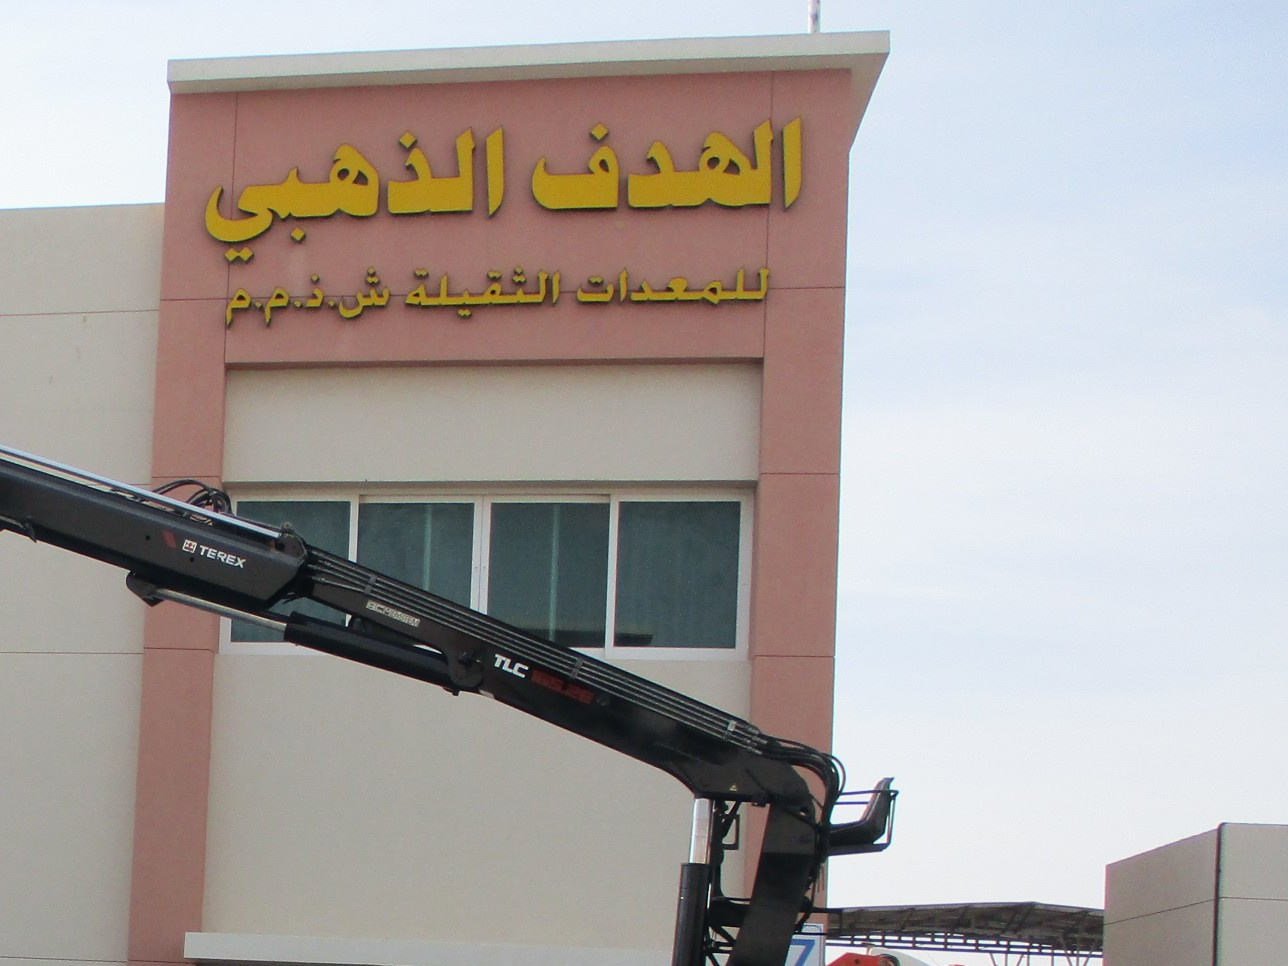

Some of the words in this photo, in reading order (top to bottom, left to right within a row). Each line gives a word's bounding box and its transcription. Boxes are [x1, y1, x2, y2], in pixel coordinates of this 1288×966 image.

[531, 115, 802, 209] الهدف
[204, 125, 506, 262] الذهبي
[404, 266, 560, 320] الثقيلة
[575, 266, 770, 304] للمعدات
[198, 544, 247, 569] TEREX
[494, 653, 529, 679] TLC
